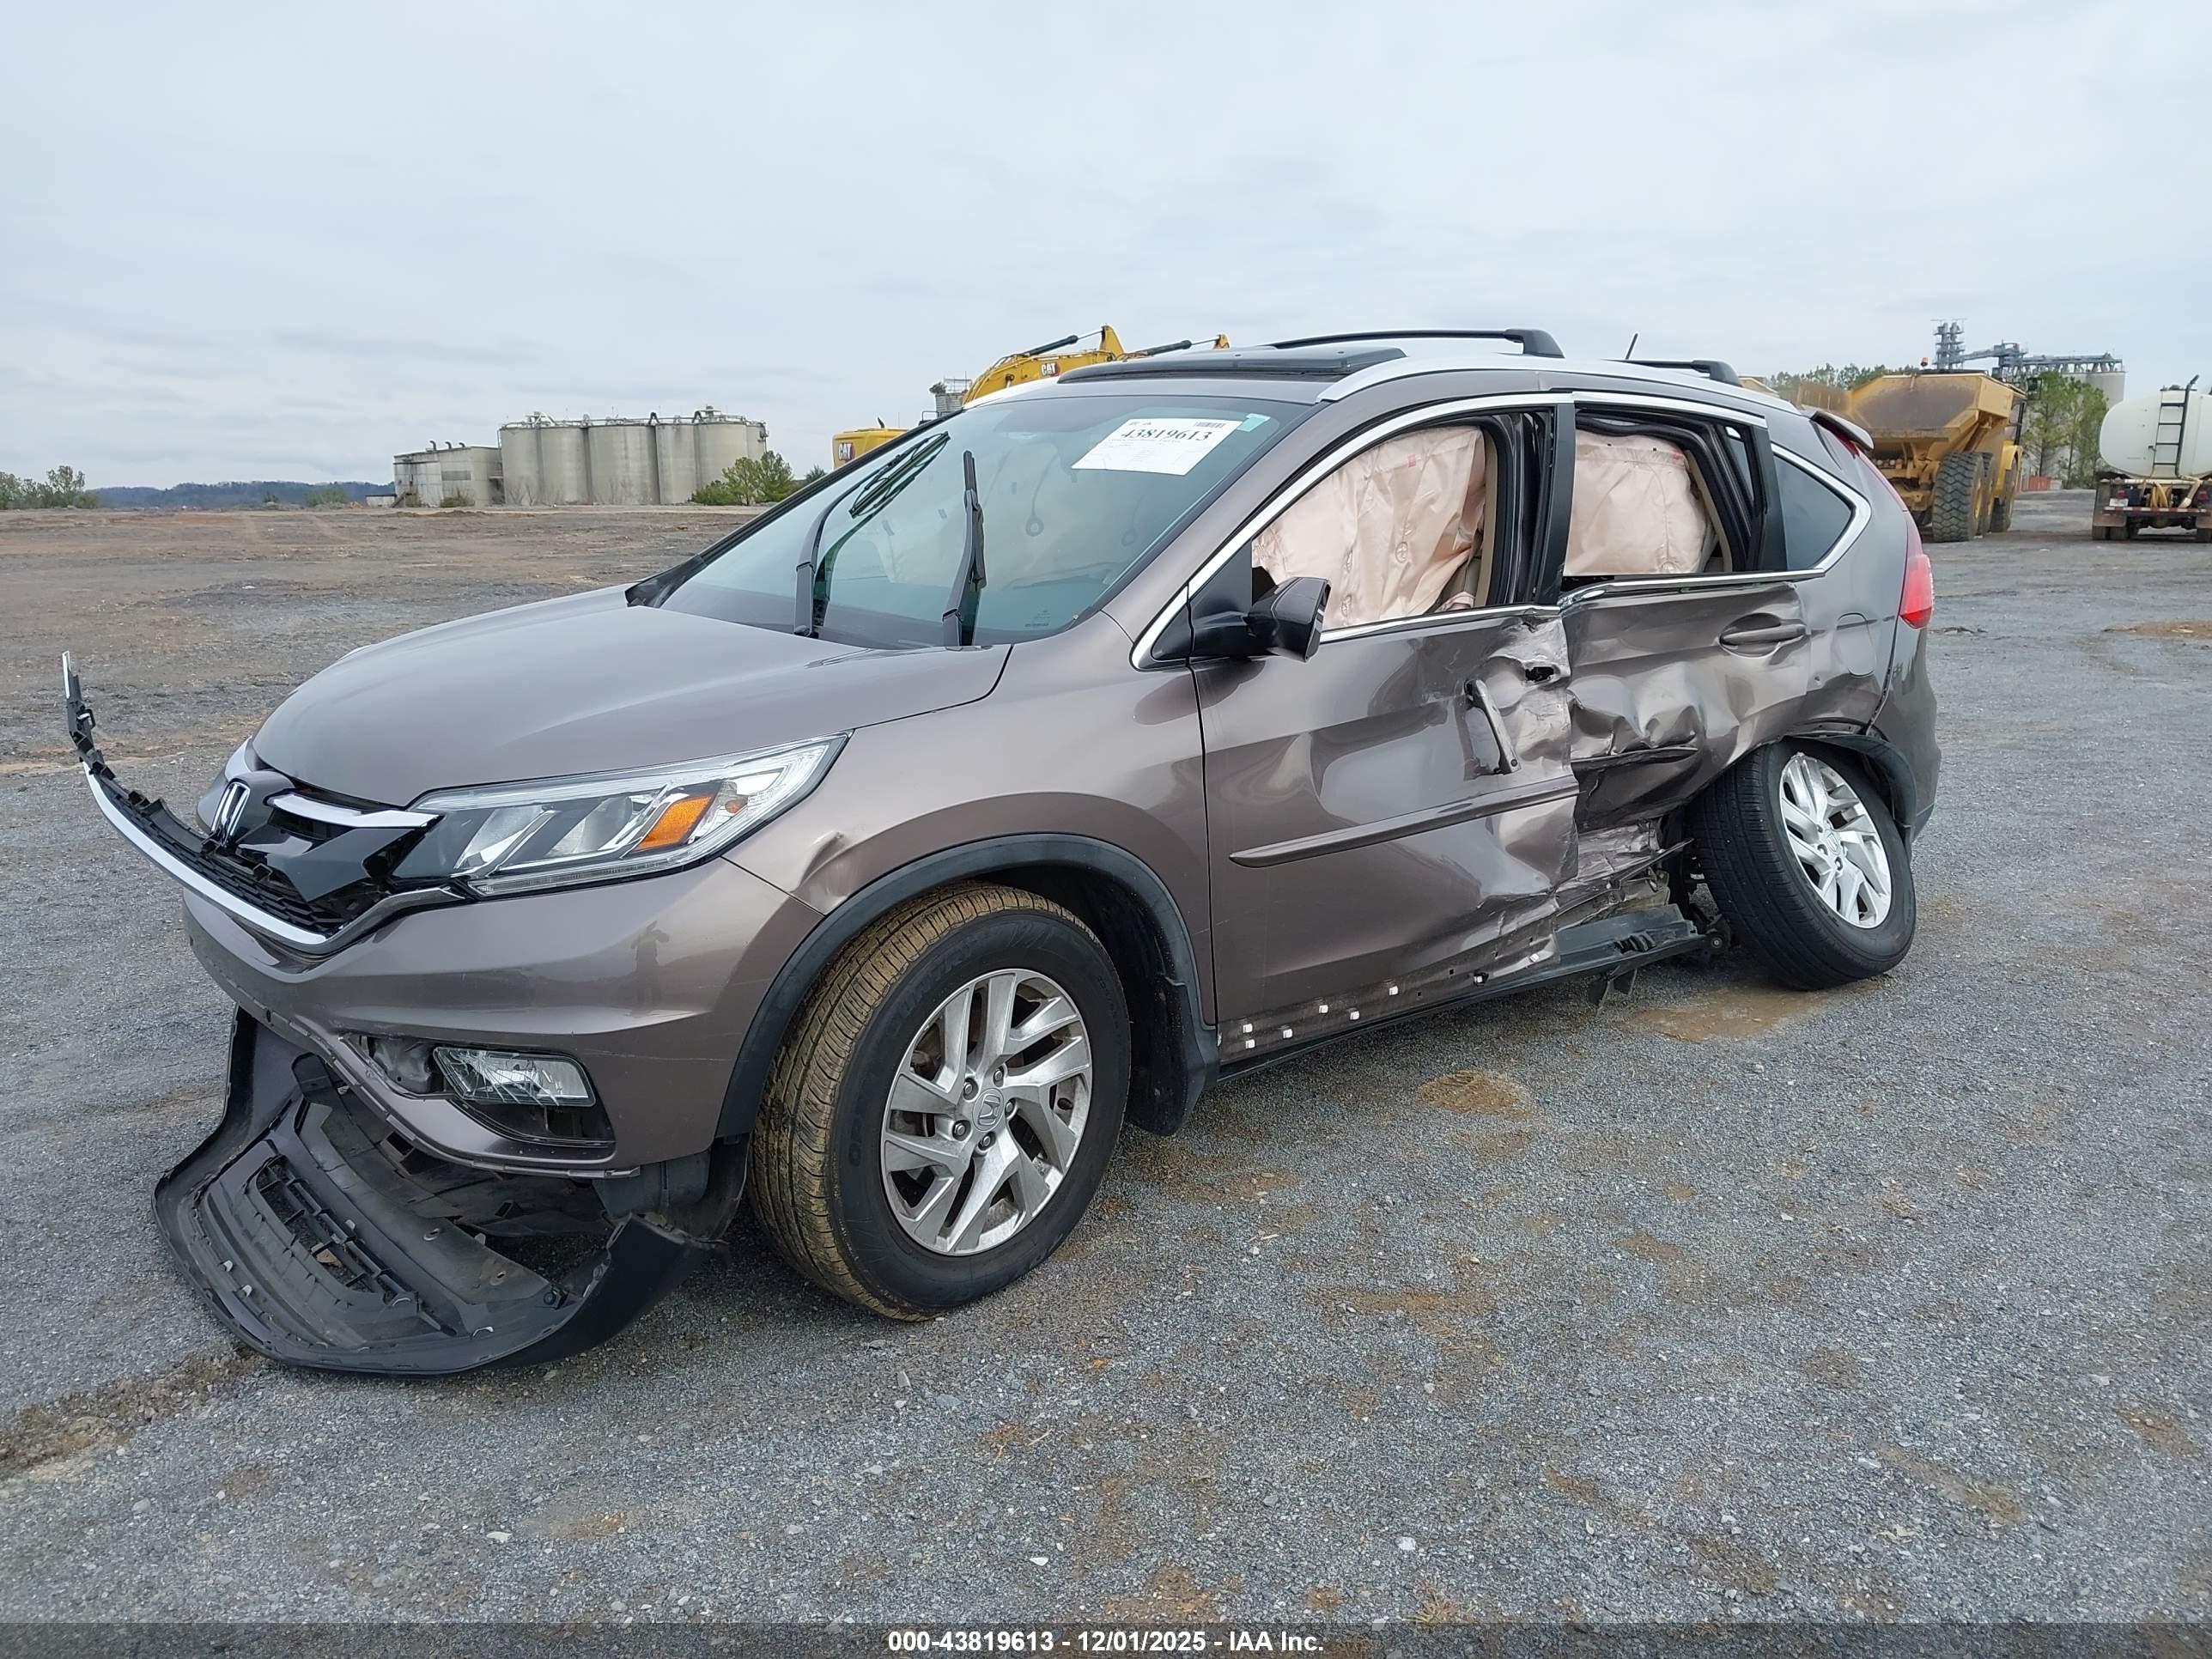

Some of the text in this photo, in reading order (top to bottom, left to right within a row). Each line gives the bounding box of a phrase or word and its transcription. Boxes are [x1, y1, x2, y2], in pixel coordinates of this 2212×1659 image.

[1041, 362, 1056, 375] CAT
[1121, 428, 1213, 442] 43819613
[838, 442, 852, 460] CAT
